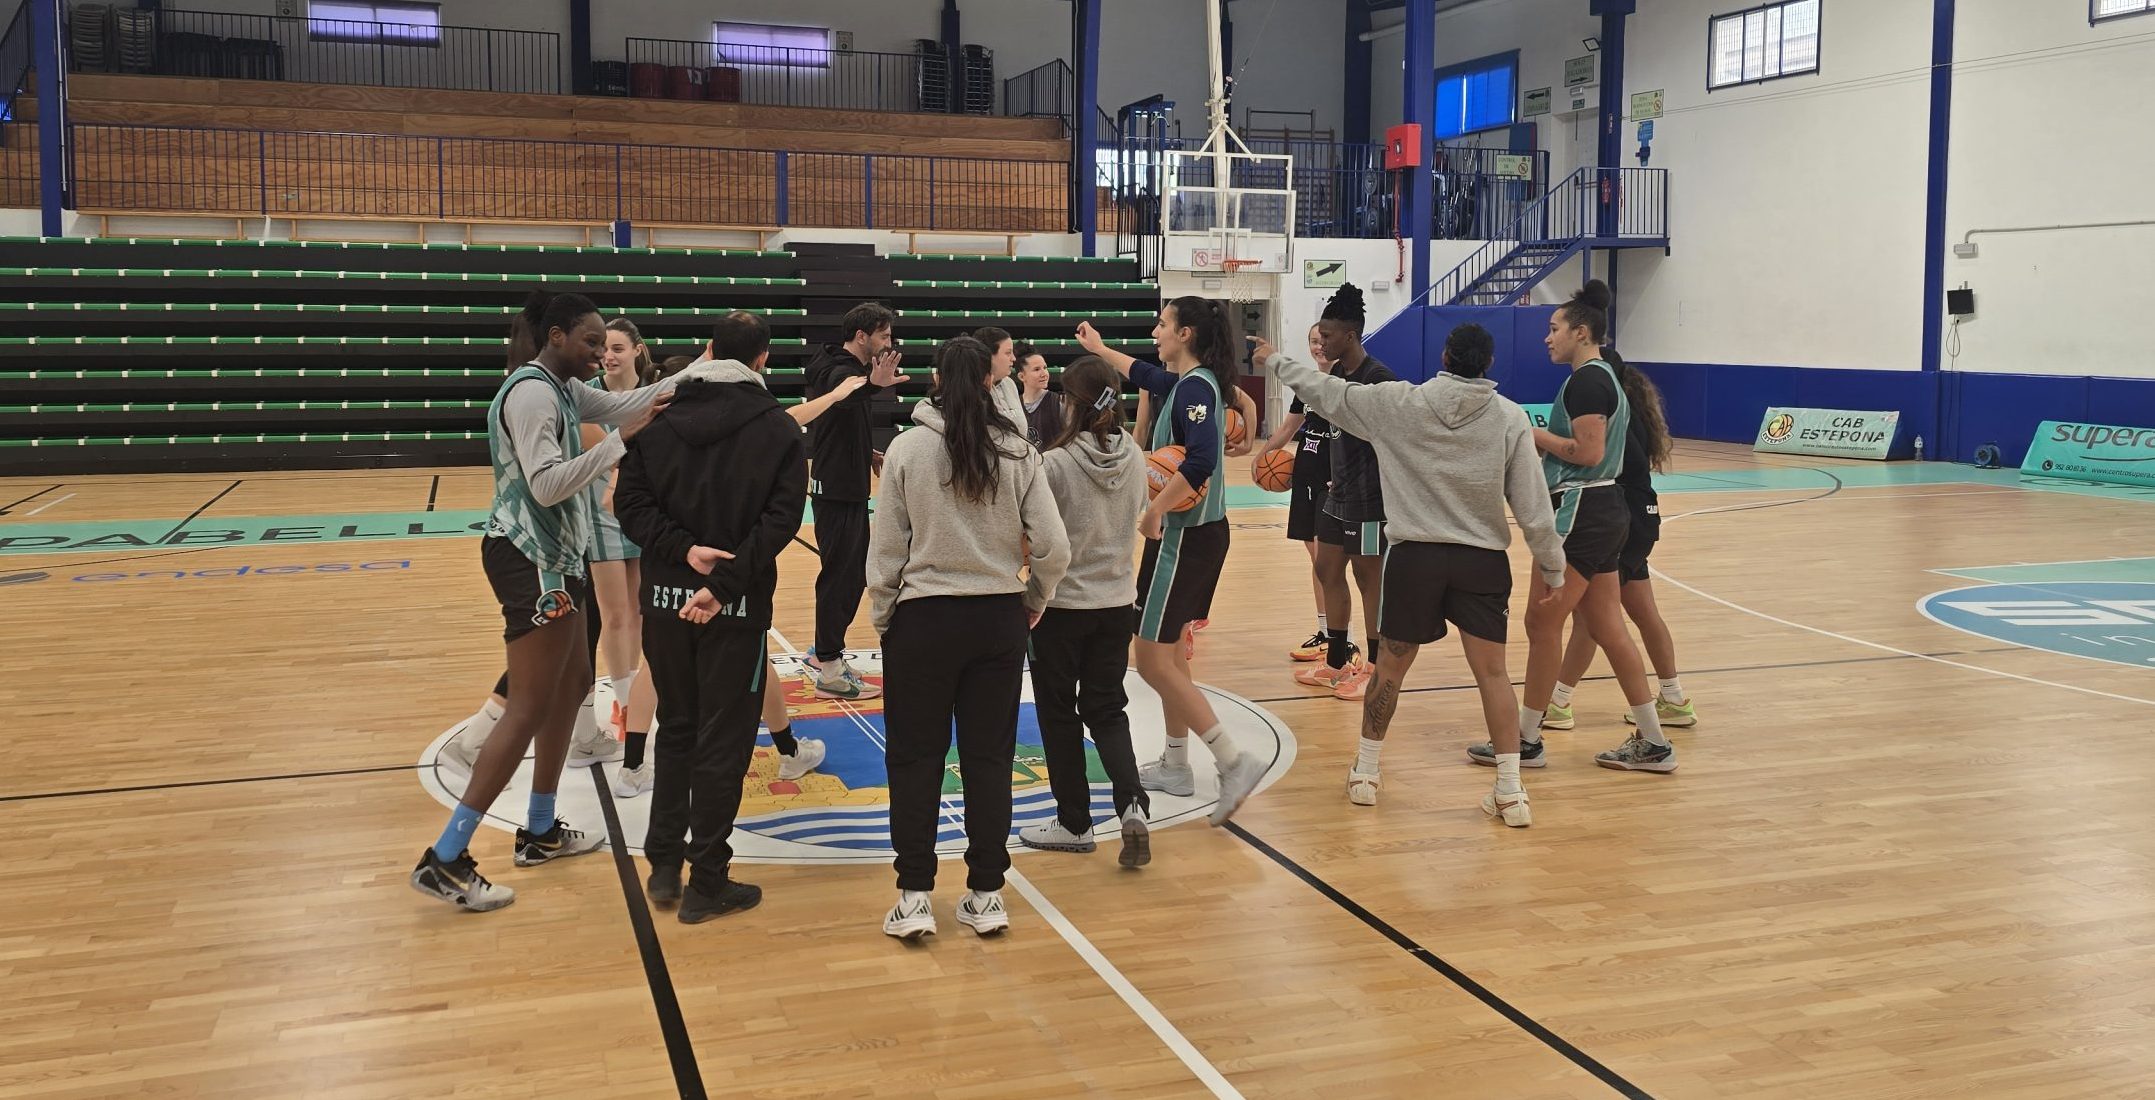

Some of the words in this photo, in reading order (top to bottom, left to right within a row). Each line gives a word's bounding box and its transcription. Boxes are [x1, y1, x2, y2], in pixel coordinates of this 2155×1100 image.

[1832, 417, 1865, 428] CAB
[1800, 428, 1885, 443] ESTEPONA
[72, 559, 411, 583] endesa
